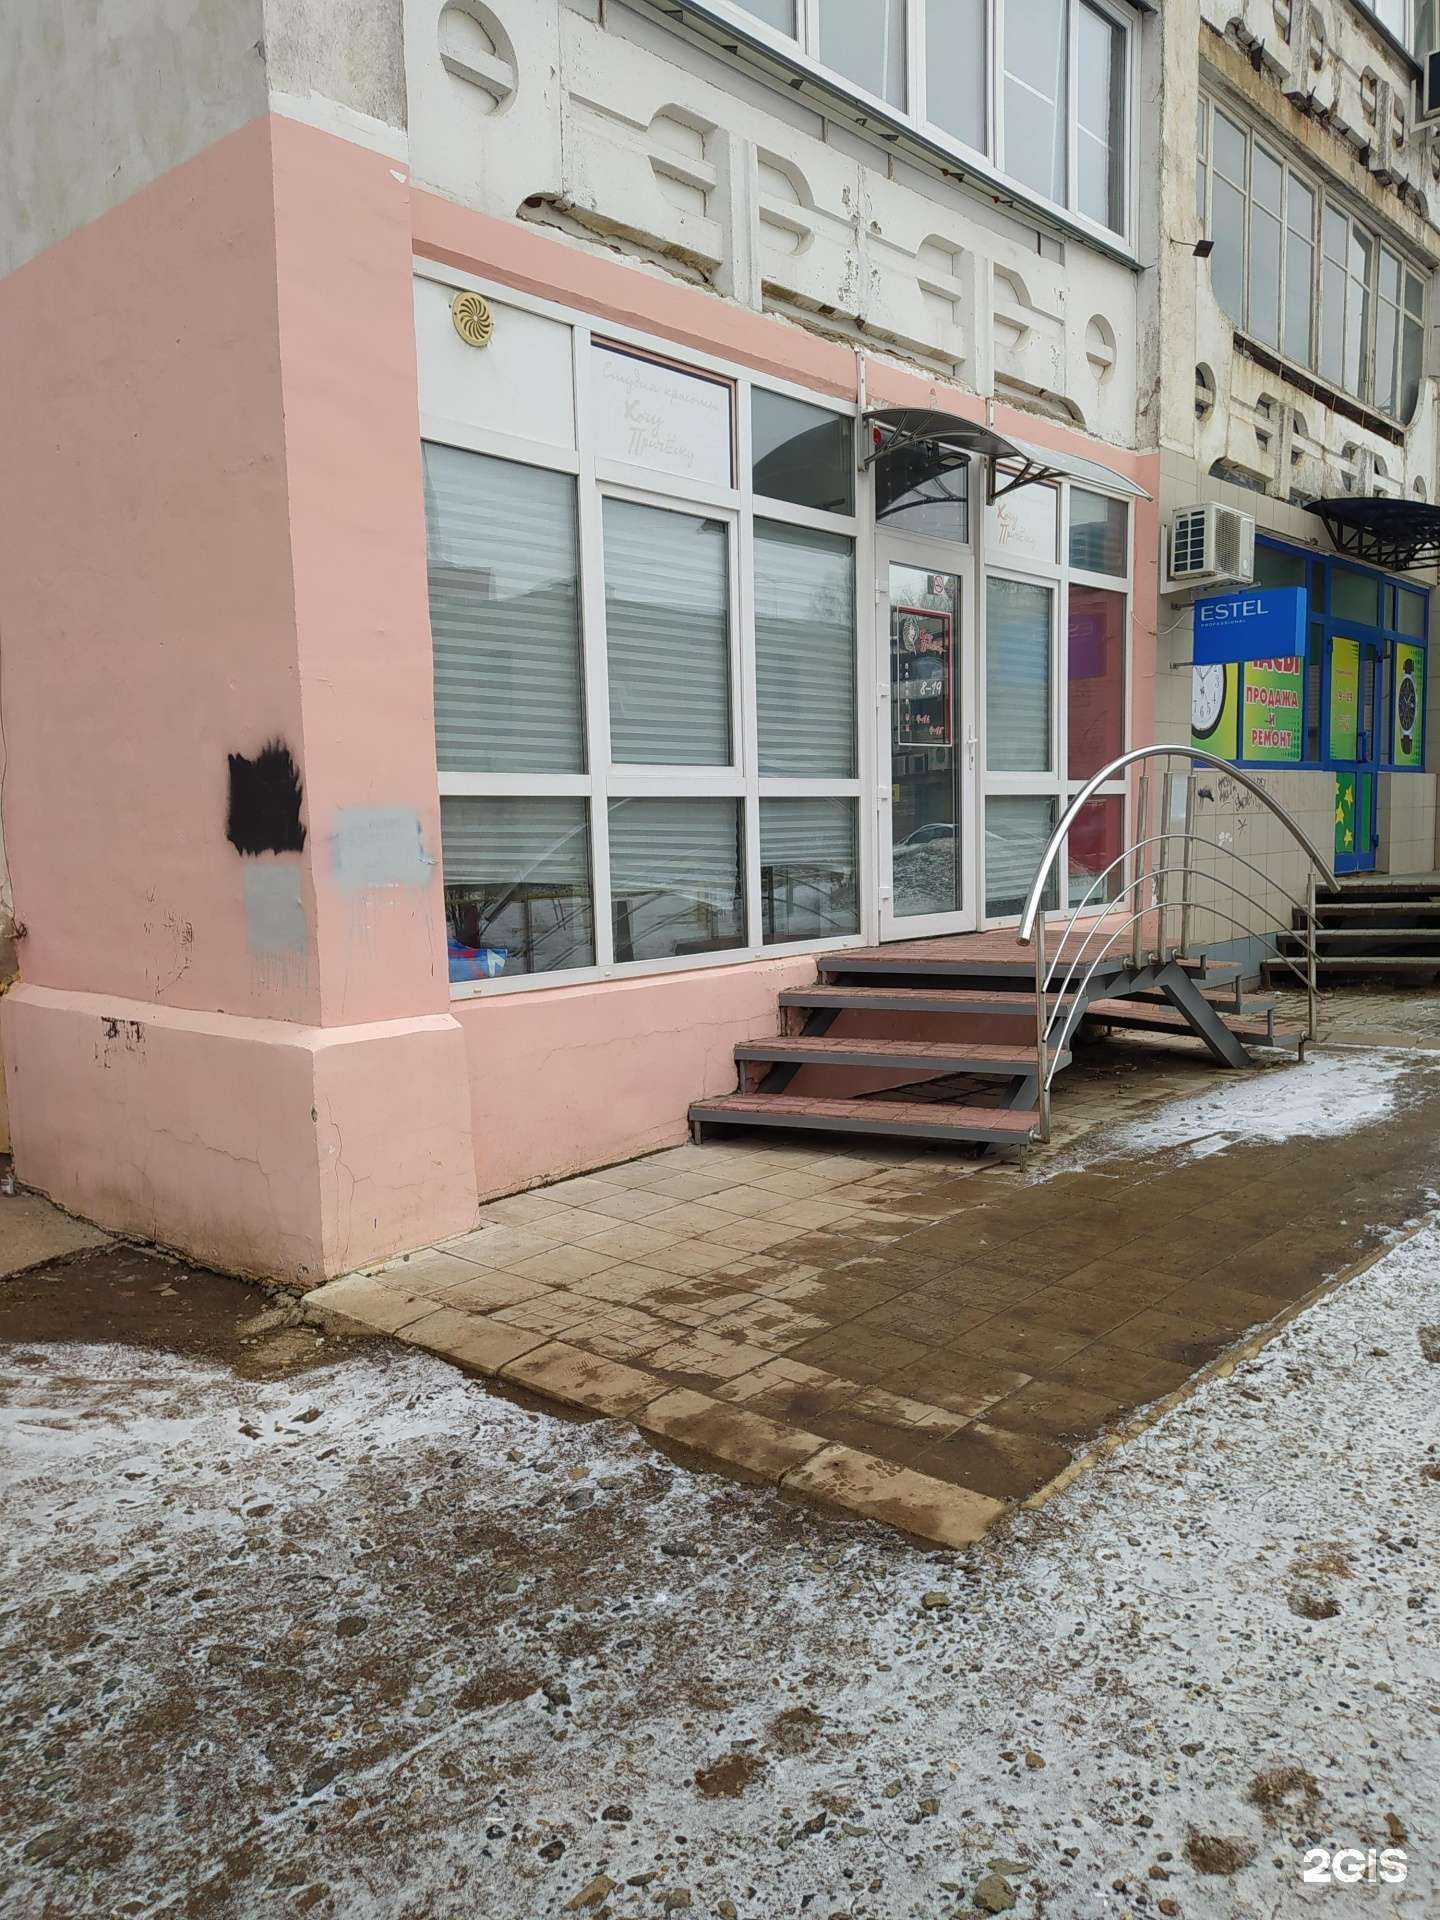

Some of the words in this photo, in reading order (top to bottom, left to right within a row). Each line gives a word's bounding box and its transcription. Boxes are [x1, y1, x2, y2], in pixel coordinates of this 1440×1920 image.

[1201, 600, 1269, 621] ESTEL
[1245, 686, 1298, 708] ПРОДАЖА
[1251, 729, 1292, 747] РЕМОНТ
